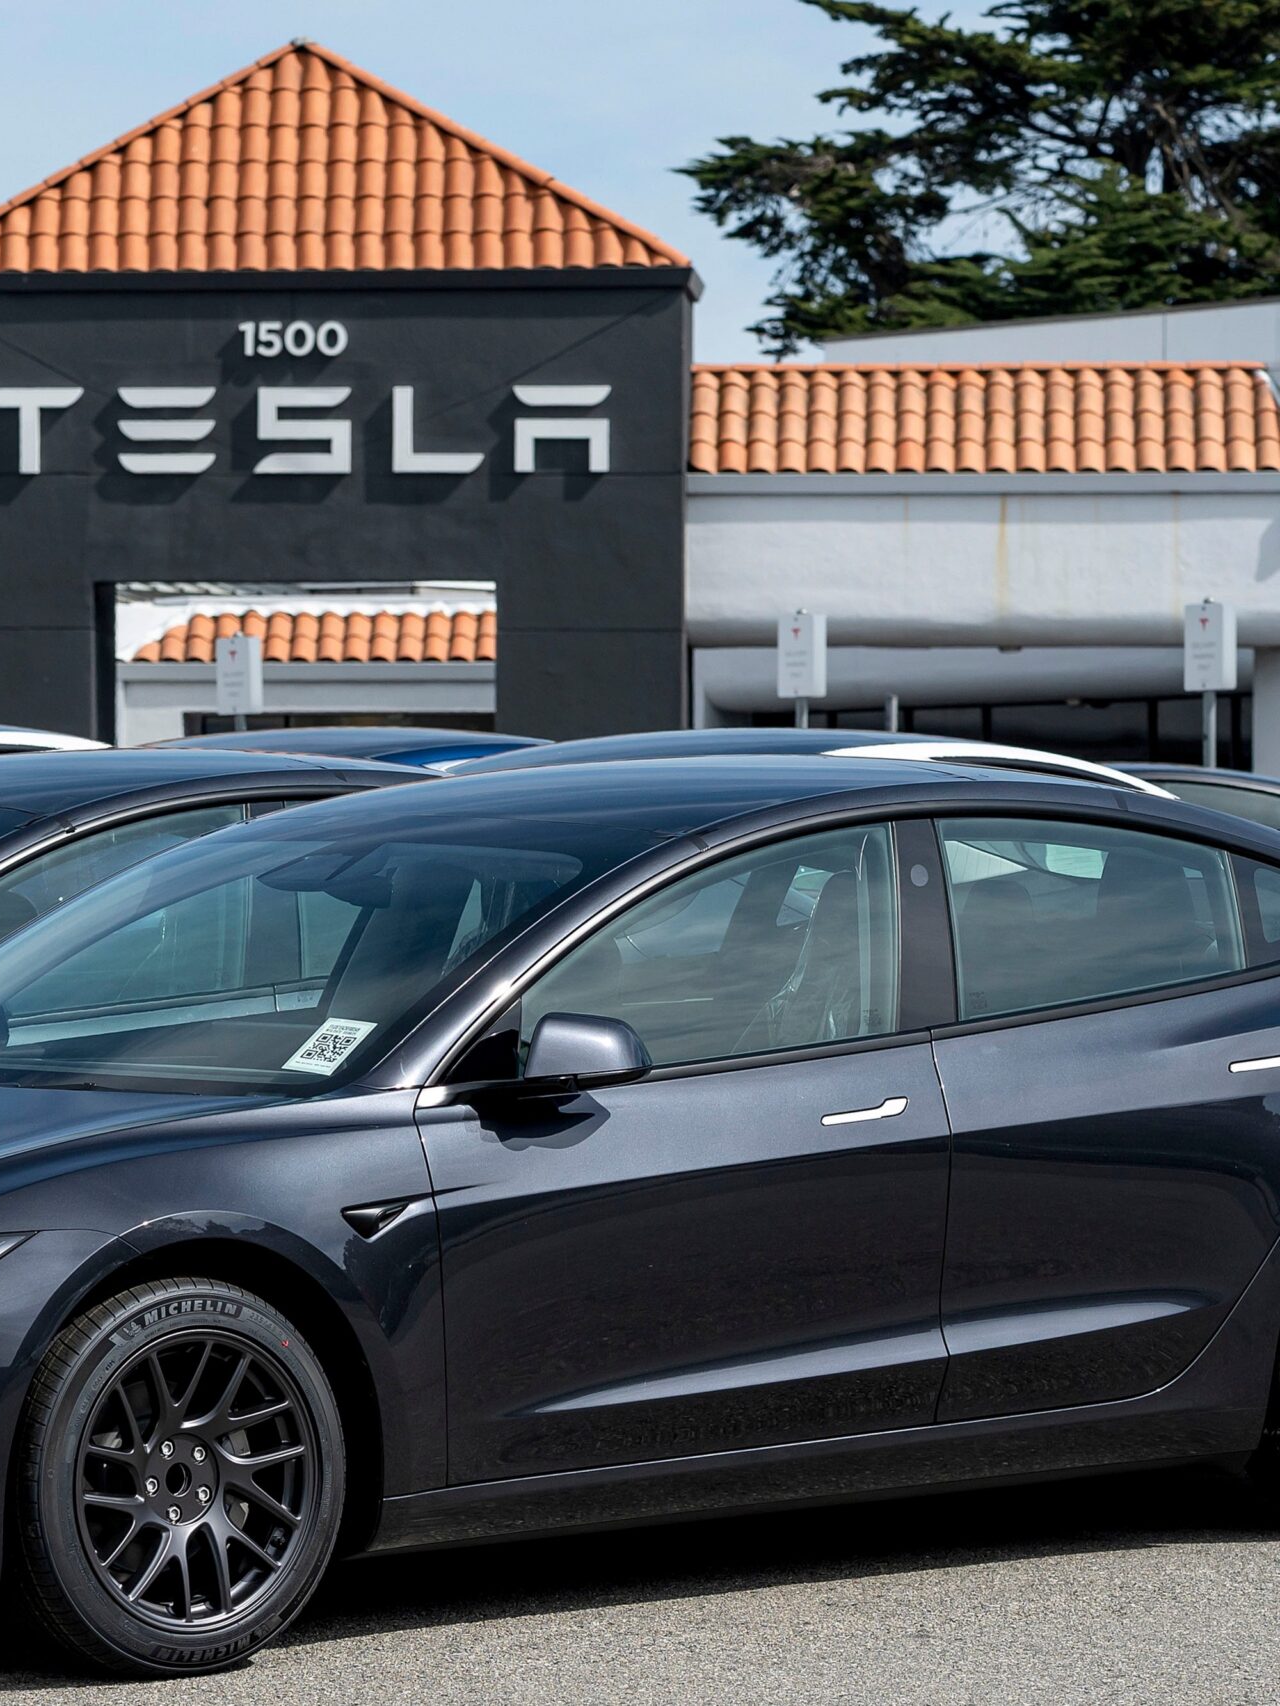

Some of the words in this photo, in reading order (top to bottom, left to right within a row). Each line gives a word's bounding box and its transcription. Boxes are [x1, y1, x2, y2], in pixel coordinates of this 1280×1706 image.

[239, 321, 348, 356] 1500
[144, 1299, 238, 1325] MICHELIN
[157, 1635, 251, 1662] MICHELIN
